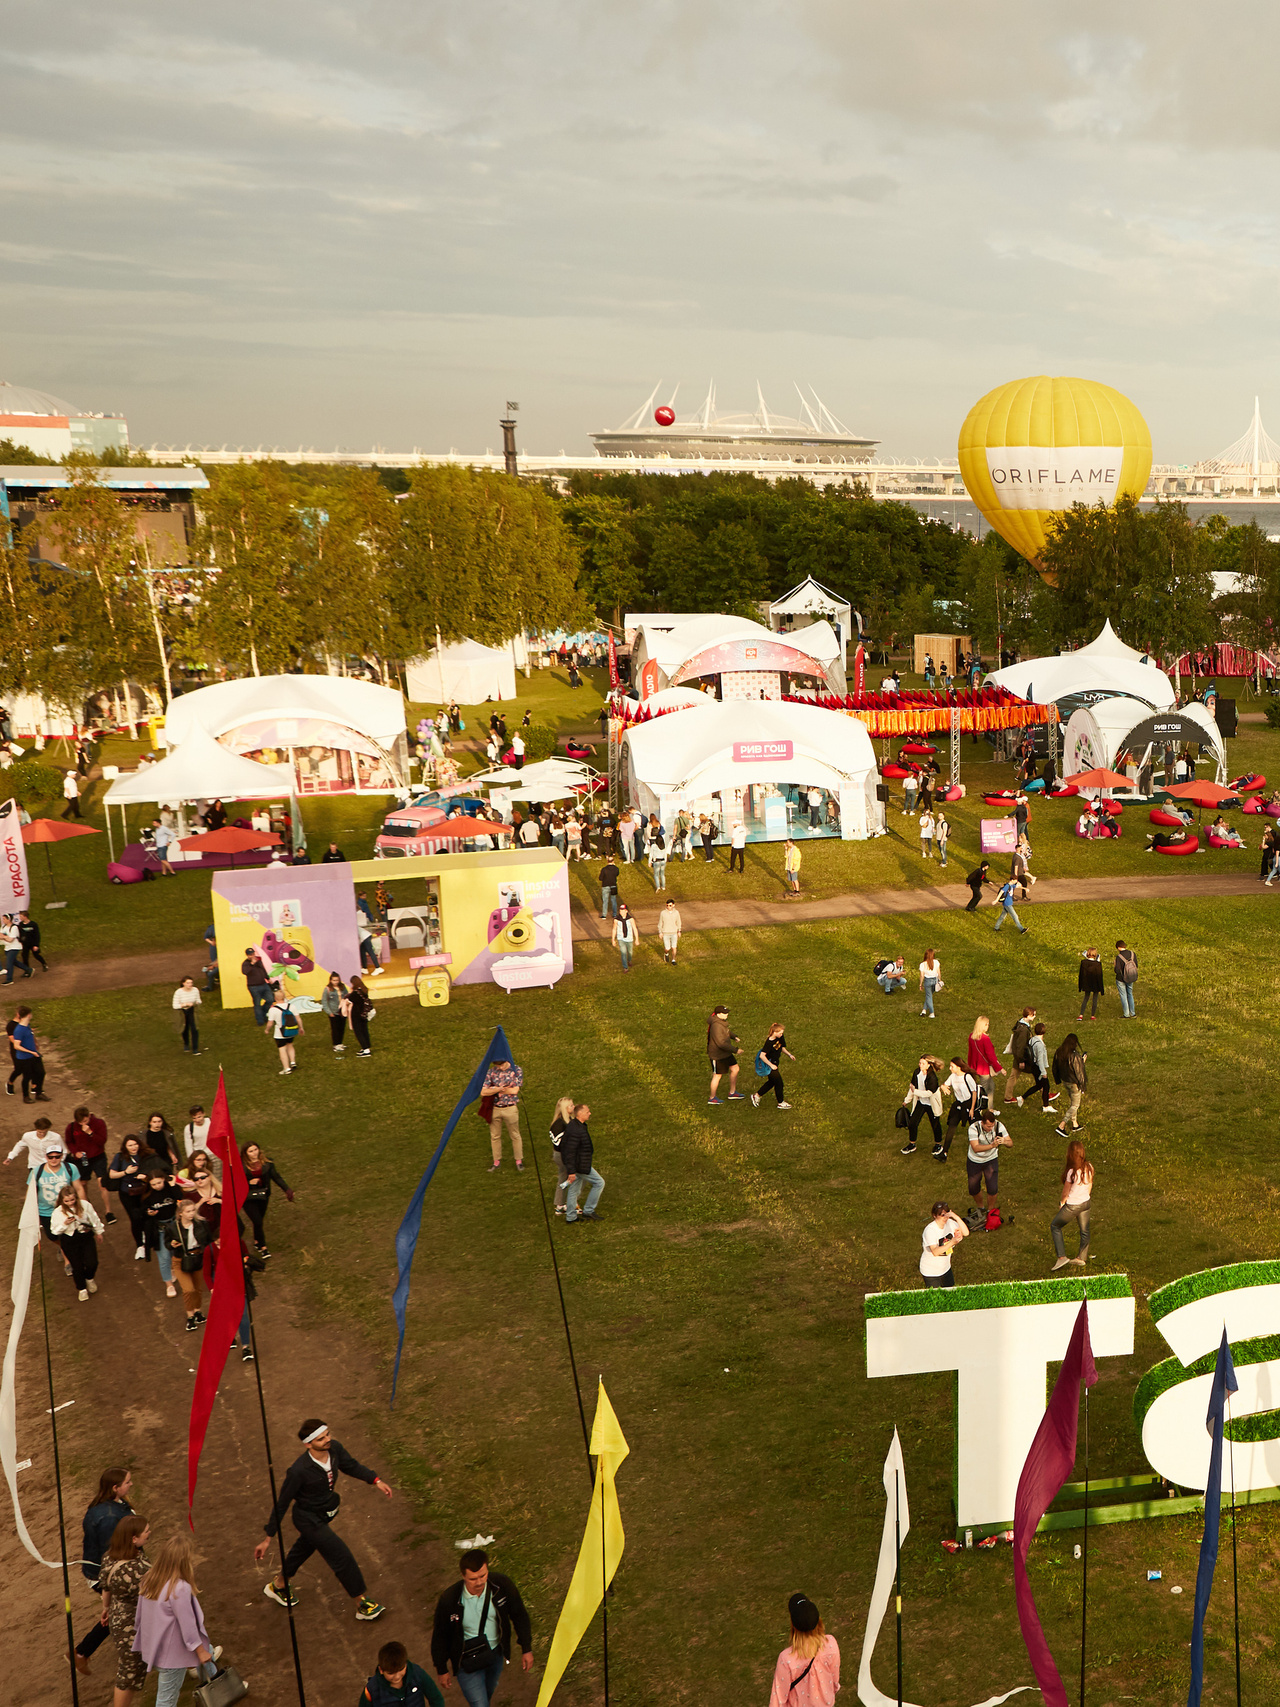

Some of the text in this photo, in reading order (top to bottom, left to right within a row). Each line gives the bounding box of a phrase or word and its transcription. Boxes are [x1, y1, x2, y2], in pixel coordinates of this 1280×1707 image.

[992, 469, 1115, 484] ORIFLAME
[740, 743, 786, 754] РИВ ГОШ
[3, 836, 26, 898] КРАСОТА
[524, 879, 561, 892] instax
[545, 891, 552, 899] 9
[229, 902, 270, 915] instax
[252, 913, 260, 921] 9
[499, 970, 533, 983] instax
